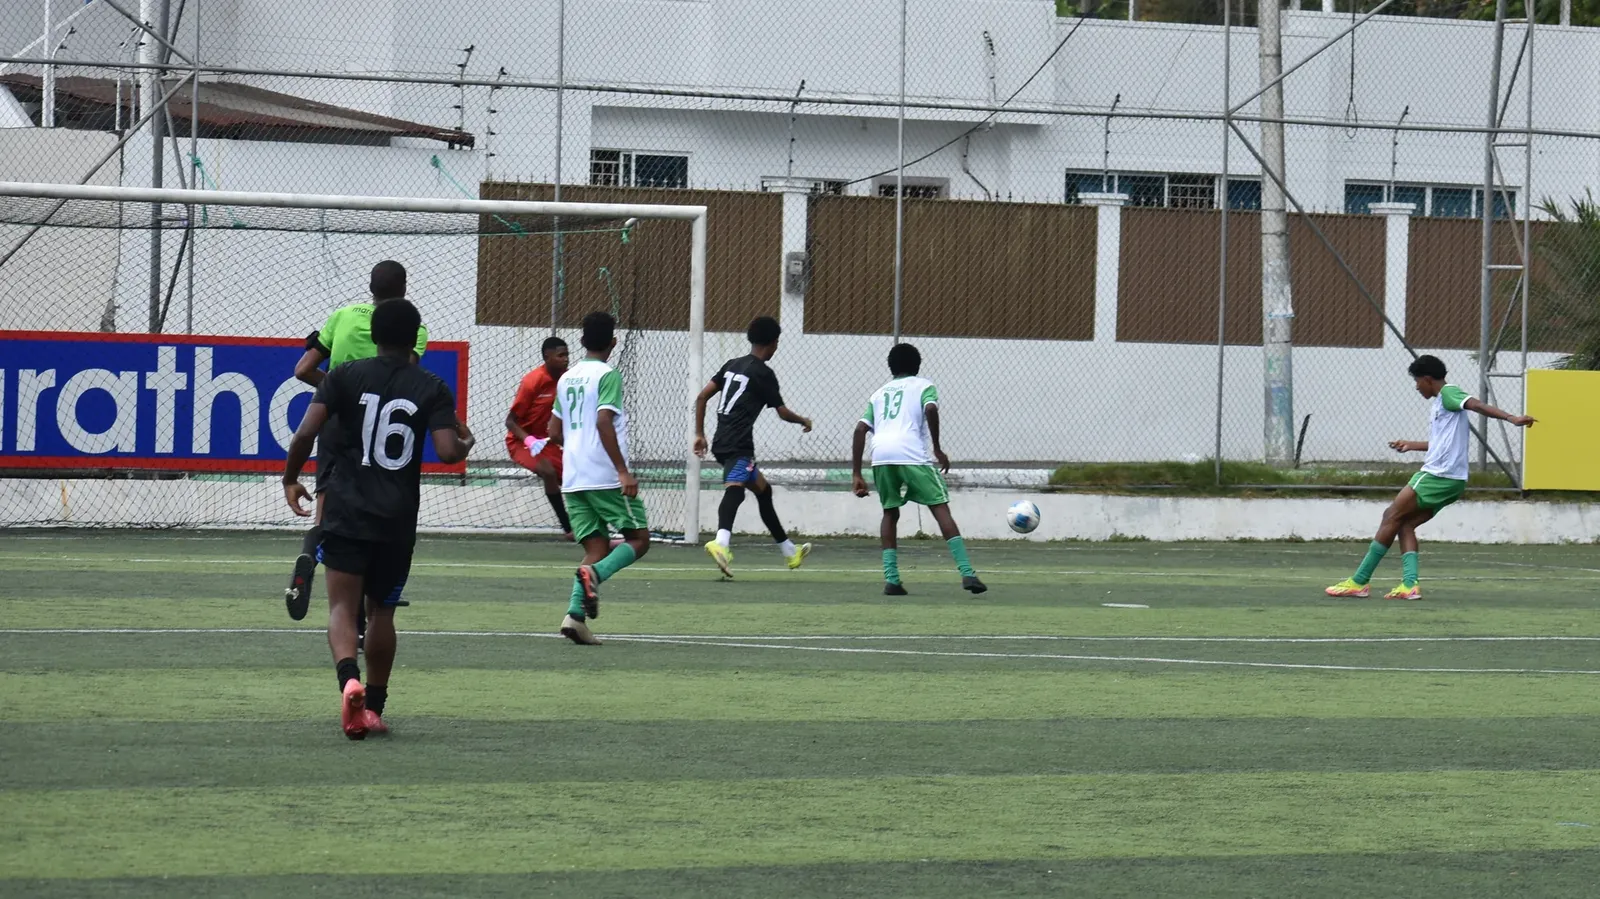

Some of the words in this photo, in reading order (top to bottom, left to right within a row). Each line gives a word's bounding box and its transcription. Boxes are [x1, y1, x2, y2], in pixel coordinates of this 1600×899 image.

[0, 346, 317, 457] rath
[566, 385, 585, 430] 22
[717, 371, 750, 415] 17
[883, 390, 904, 420] 13
[359, 393, 419, 471] 16
